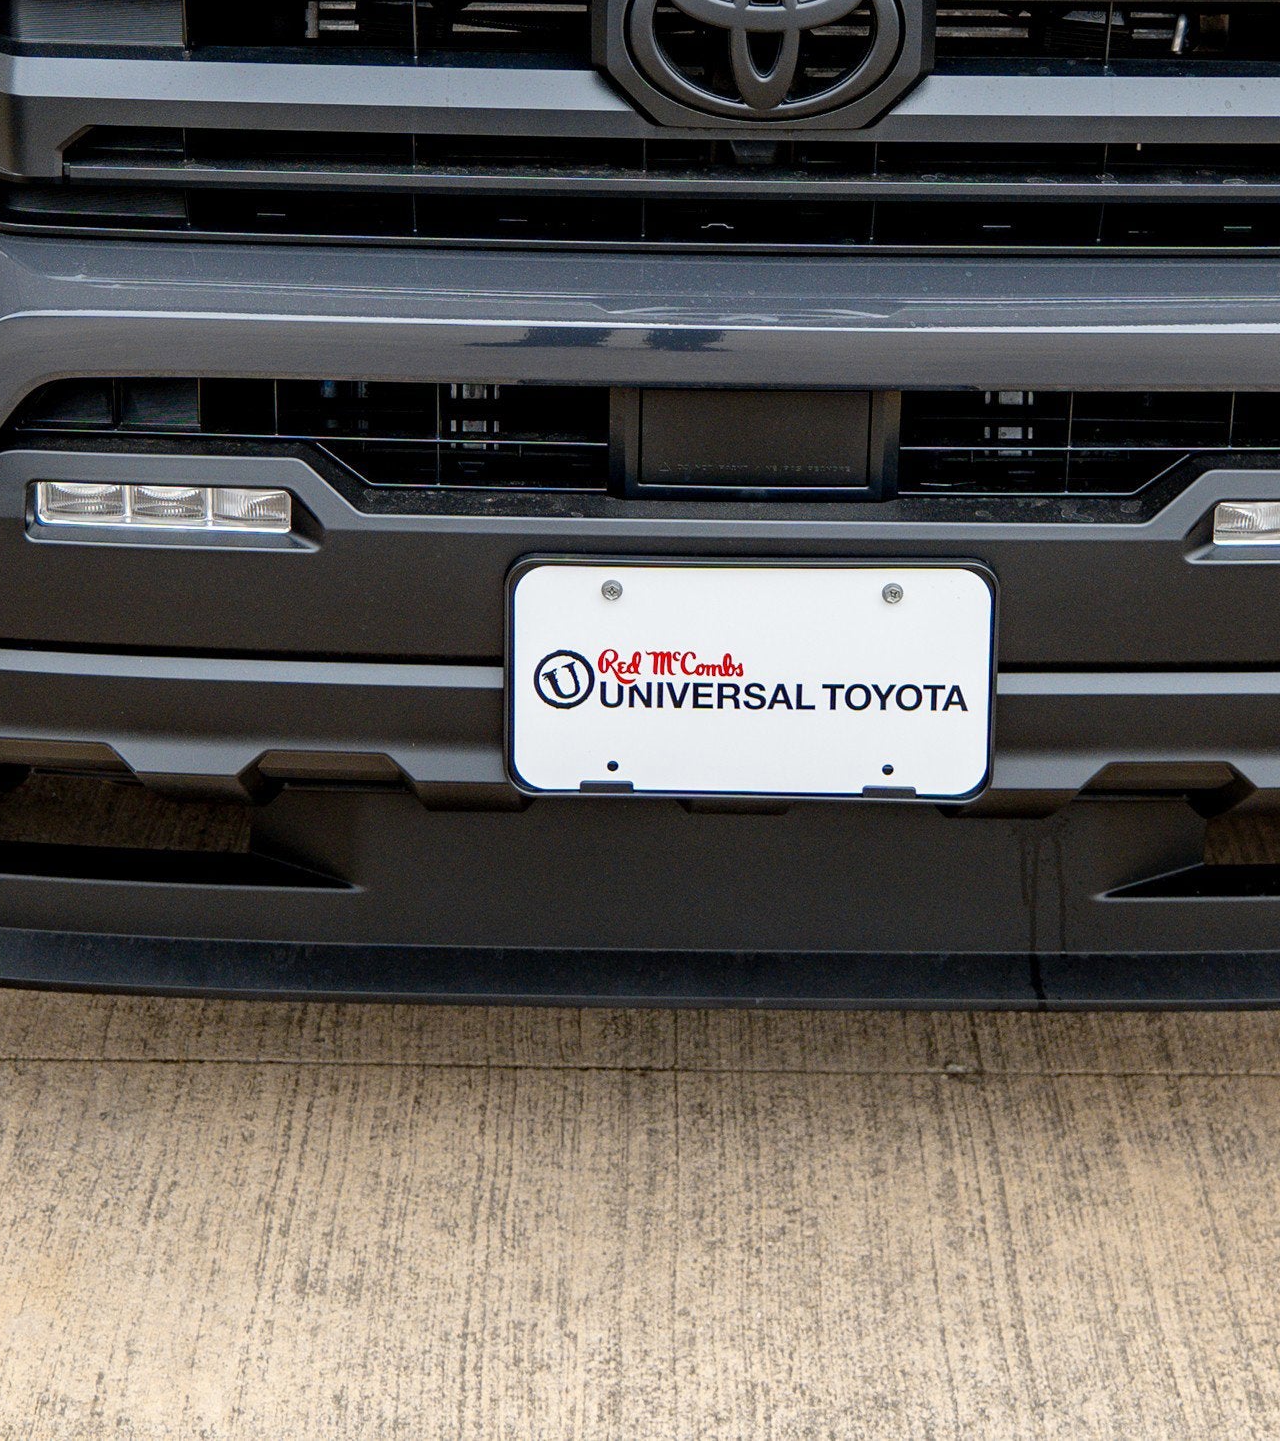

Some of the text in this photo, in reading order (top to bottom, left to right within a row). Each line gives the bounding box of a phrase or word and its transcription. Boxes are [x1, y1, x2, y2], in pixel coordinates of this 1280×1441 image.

[597, 649, 744, 685] Red McCombs
[600, 681, 968, 712] UNIVERSAL TOYOTA
